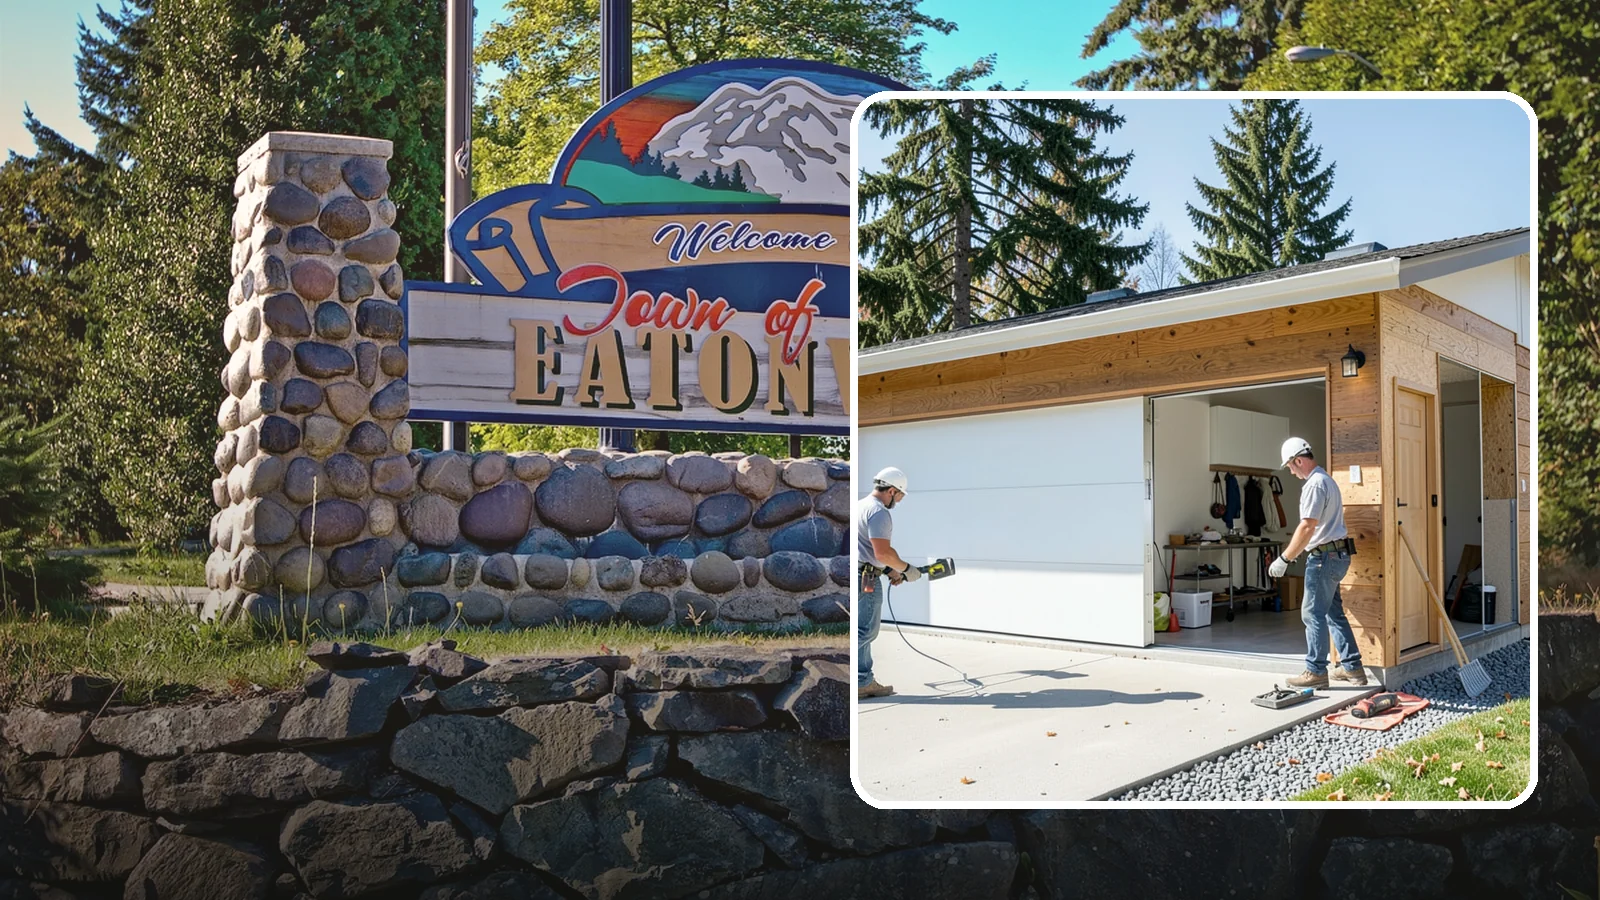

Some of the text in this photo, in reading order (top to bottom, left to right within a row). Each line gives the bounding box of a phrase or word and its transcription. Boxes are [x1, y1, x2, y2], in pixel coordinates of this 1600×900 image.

[653, 220, 838, 263] Welcome
[556, 263, 826, 365] Town of
